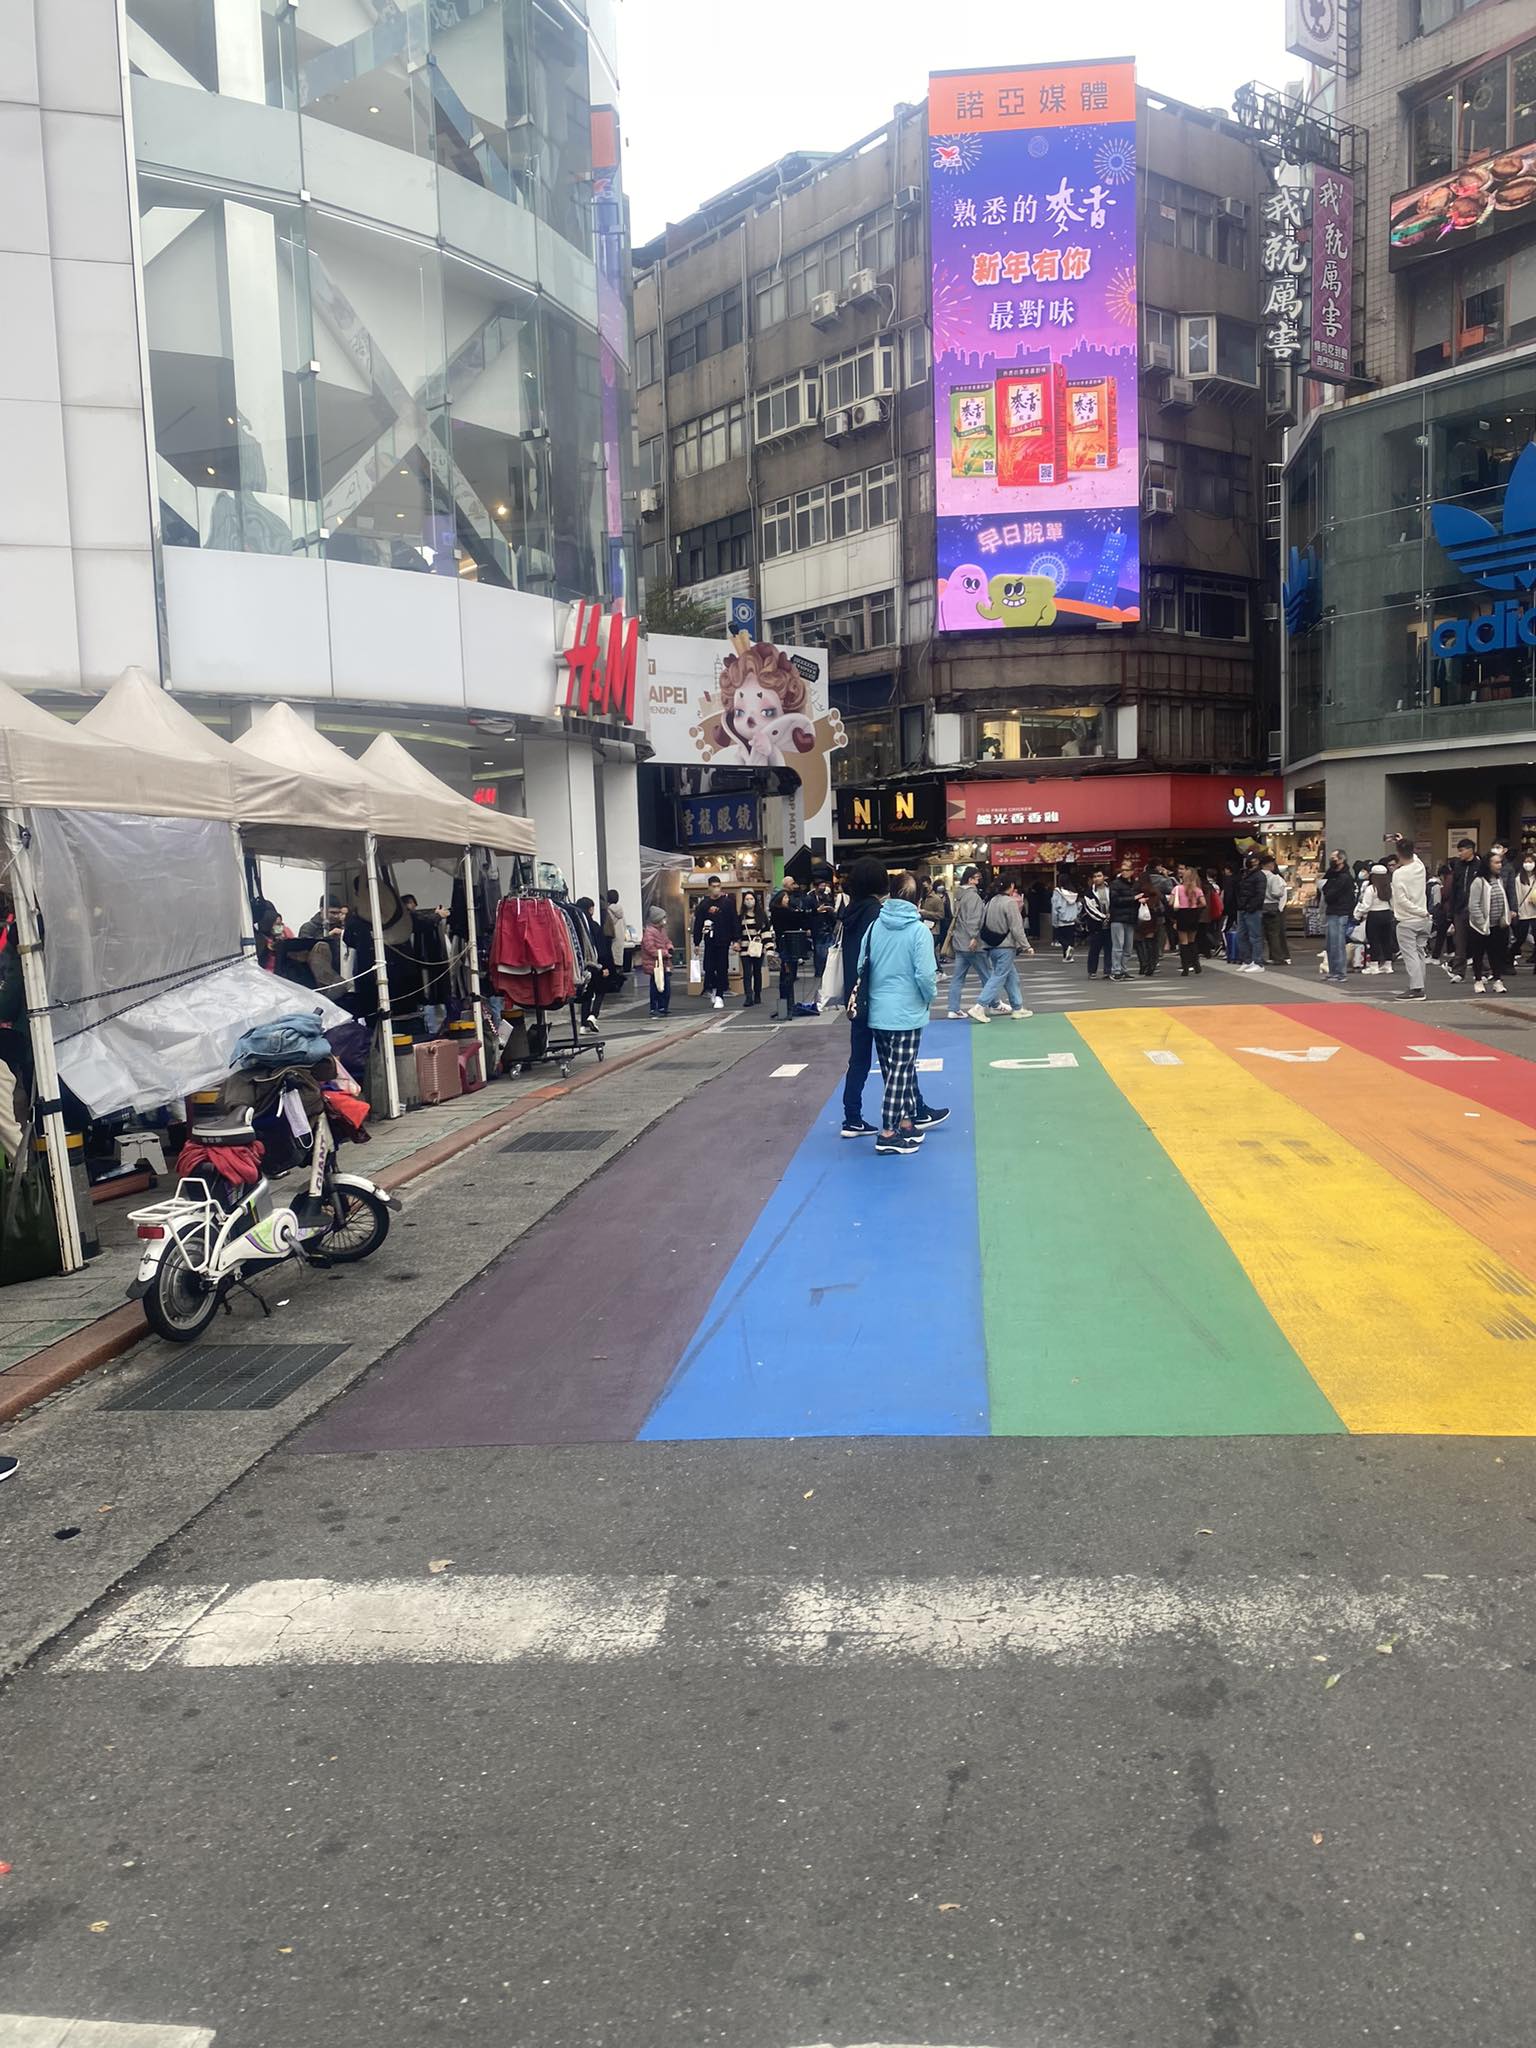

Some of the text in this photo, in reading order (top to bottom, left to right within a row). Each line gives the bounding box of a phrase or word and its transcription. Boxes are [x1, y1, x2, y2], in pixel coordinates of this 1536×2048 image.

[957, 81, 1109, 120] 諾亞媒體
[952, 177, 1117, 238] 熟悉的麥香
[972, 247, 1091, 286] 新年有你
[990, 297, 1076, 331] 最對味
[977, 522, 1064, 555] 早日脫單
[563, 599, 640, 726] H&M
[649, 685, 688, 704] AIPEI
[649, 706, 677, 715] ENDING
[1228, 788, 1271, 817] J&G
[789, 814, 797, 846] MART
[316, 1135, 326, 1190] GIANT
